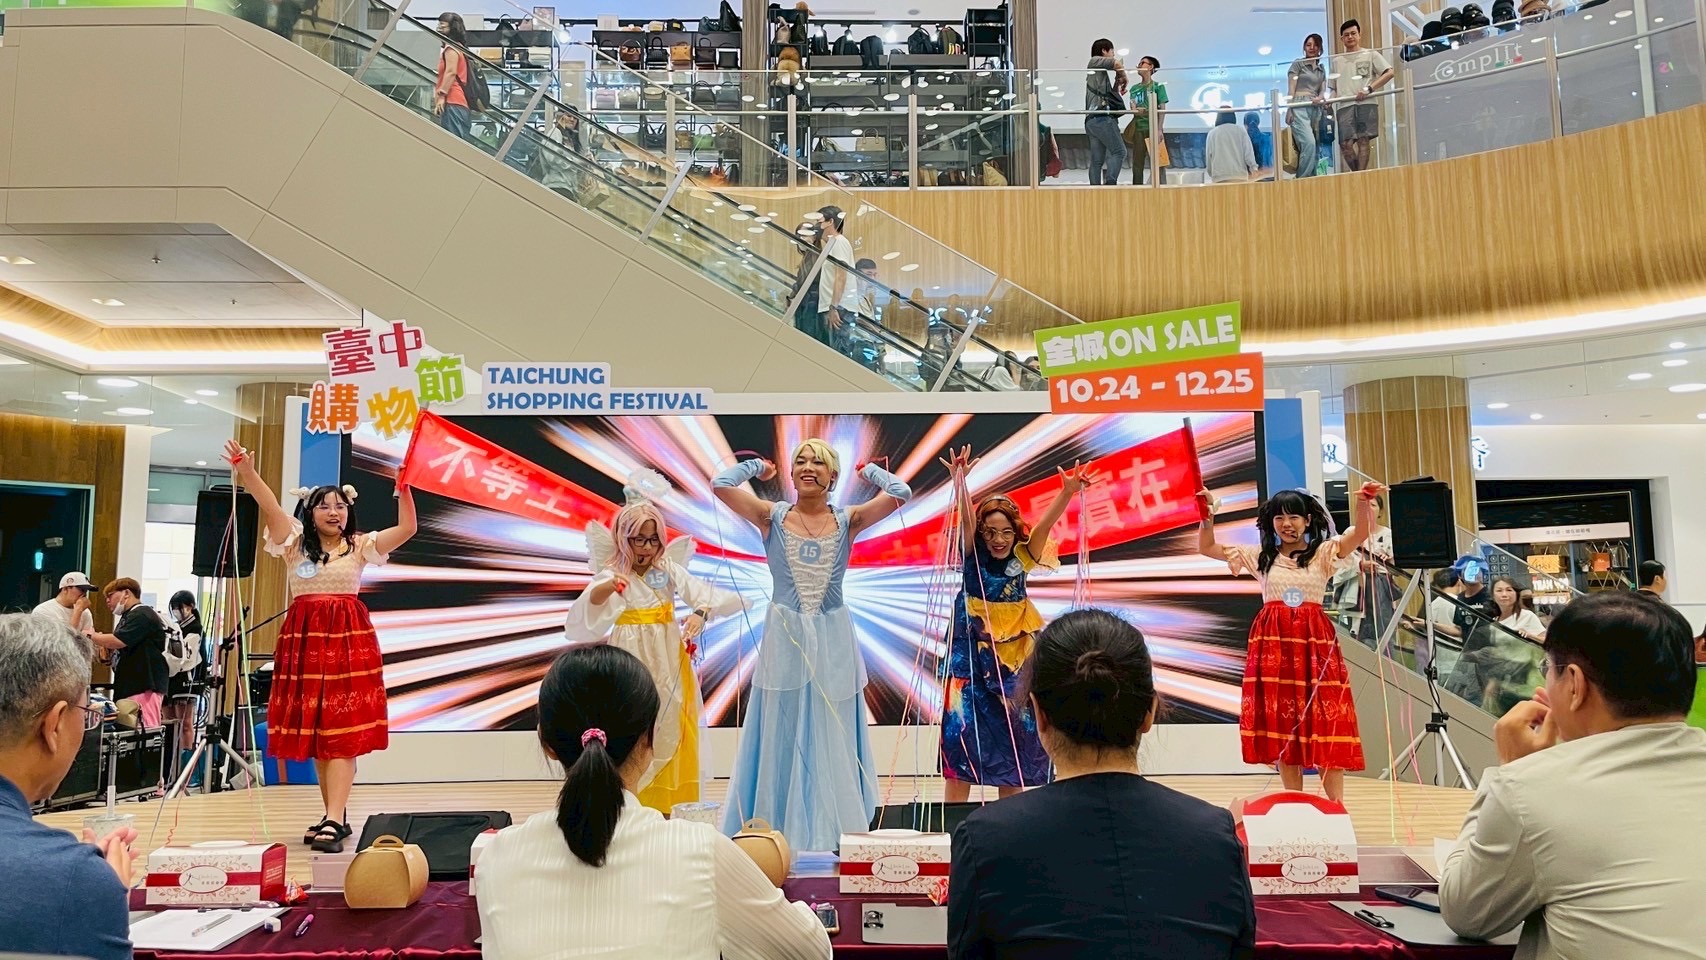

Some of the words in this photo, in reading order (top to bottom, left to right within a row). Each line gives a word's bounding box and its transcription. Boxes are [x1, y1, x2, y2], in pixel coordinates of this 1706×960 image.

[325, 322, 423, 377] 臺中
[1042, 331, 1108, 368] 全城
[1108, 325, 1157, 357] ON
[1163, 315, 1236, 350] SALE
[487, 367, 605, 385] TAICHUNG
[1056, 375, 1141, 404] 10.24
[1175, 368, 1255, 397] 12.25
[308, 355, 466, 439] 購物節
[487, 392, 604, 410] SHOPPING
[609, 392, 709, 410] FESTIVAL
[801, 545, 818, 558] 15
[299, 564, 316, 576] 15
[1006, 560, 1021, 576] 15
[648, 571, 665, 585] 15
[1285, 592, 1301, 604] 15
